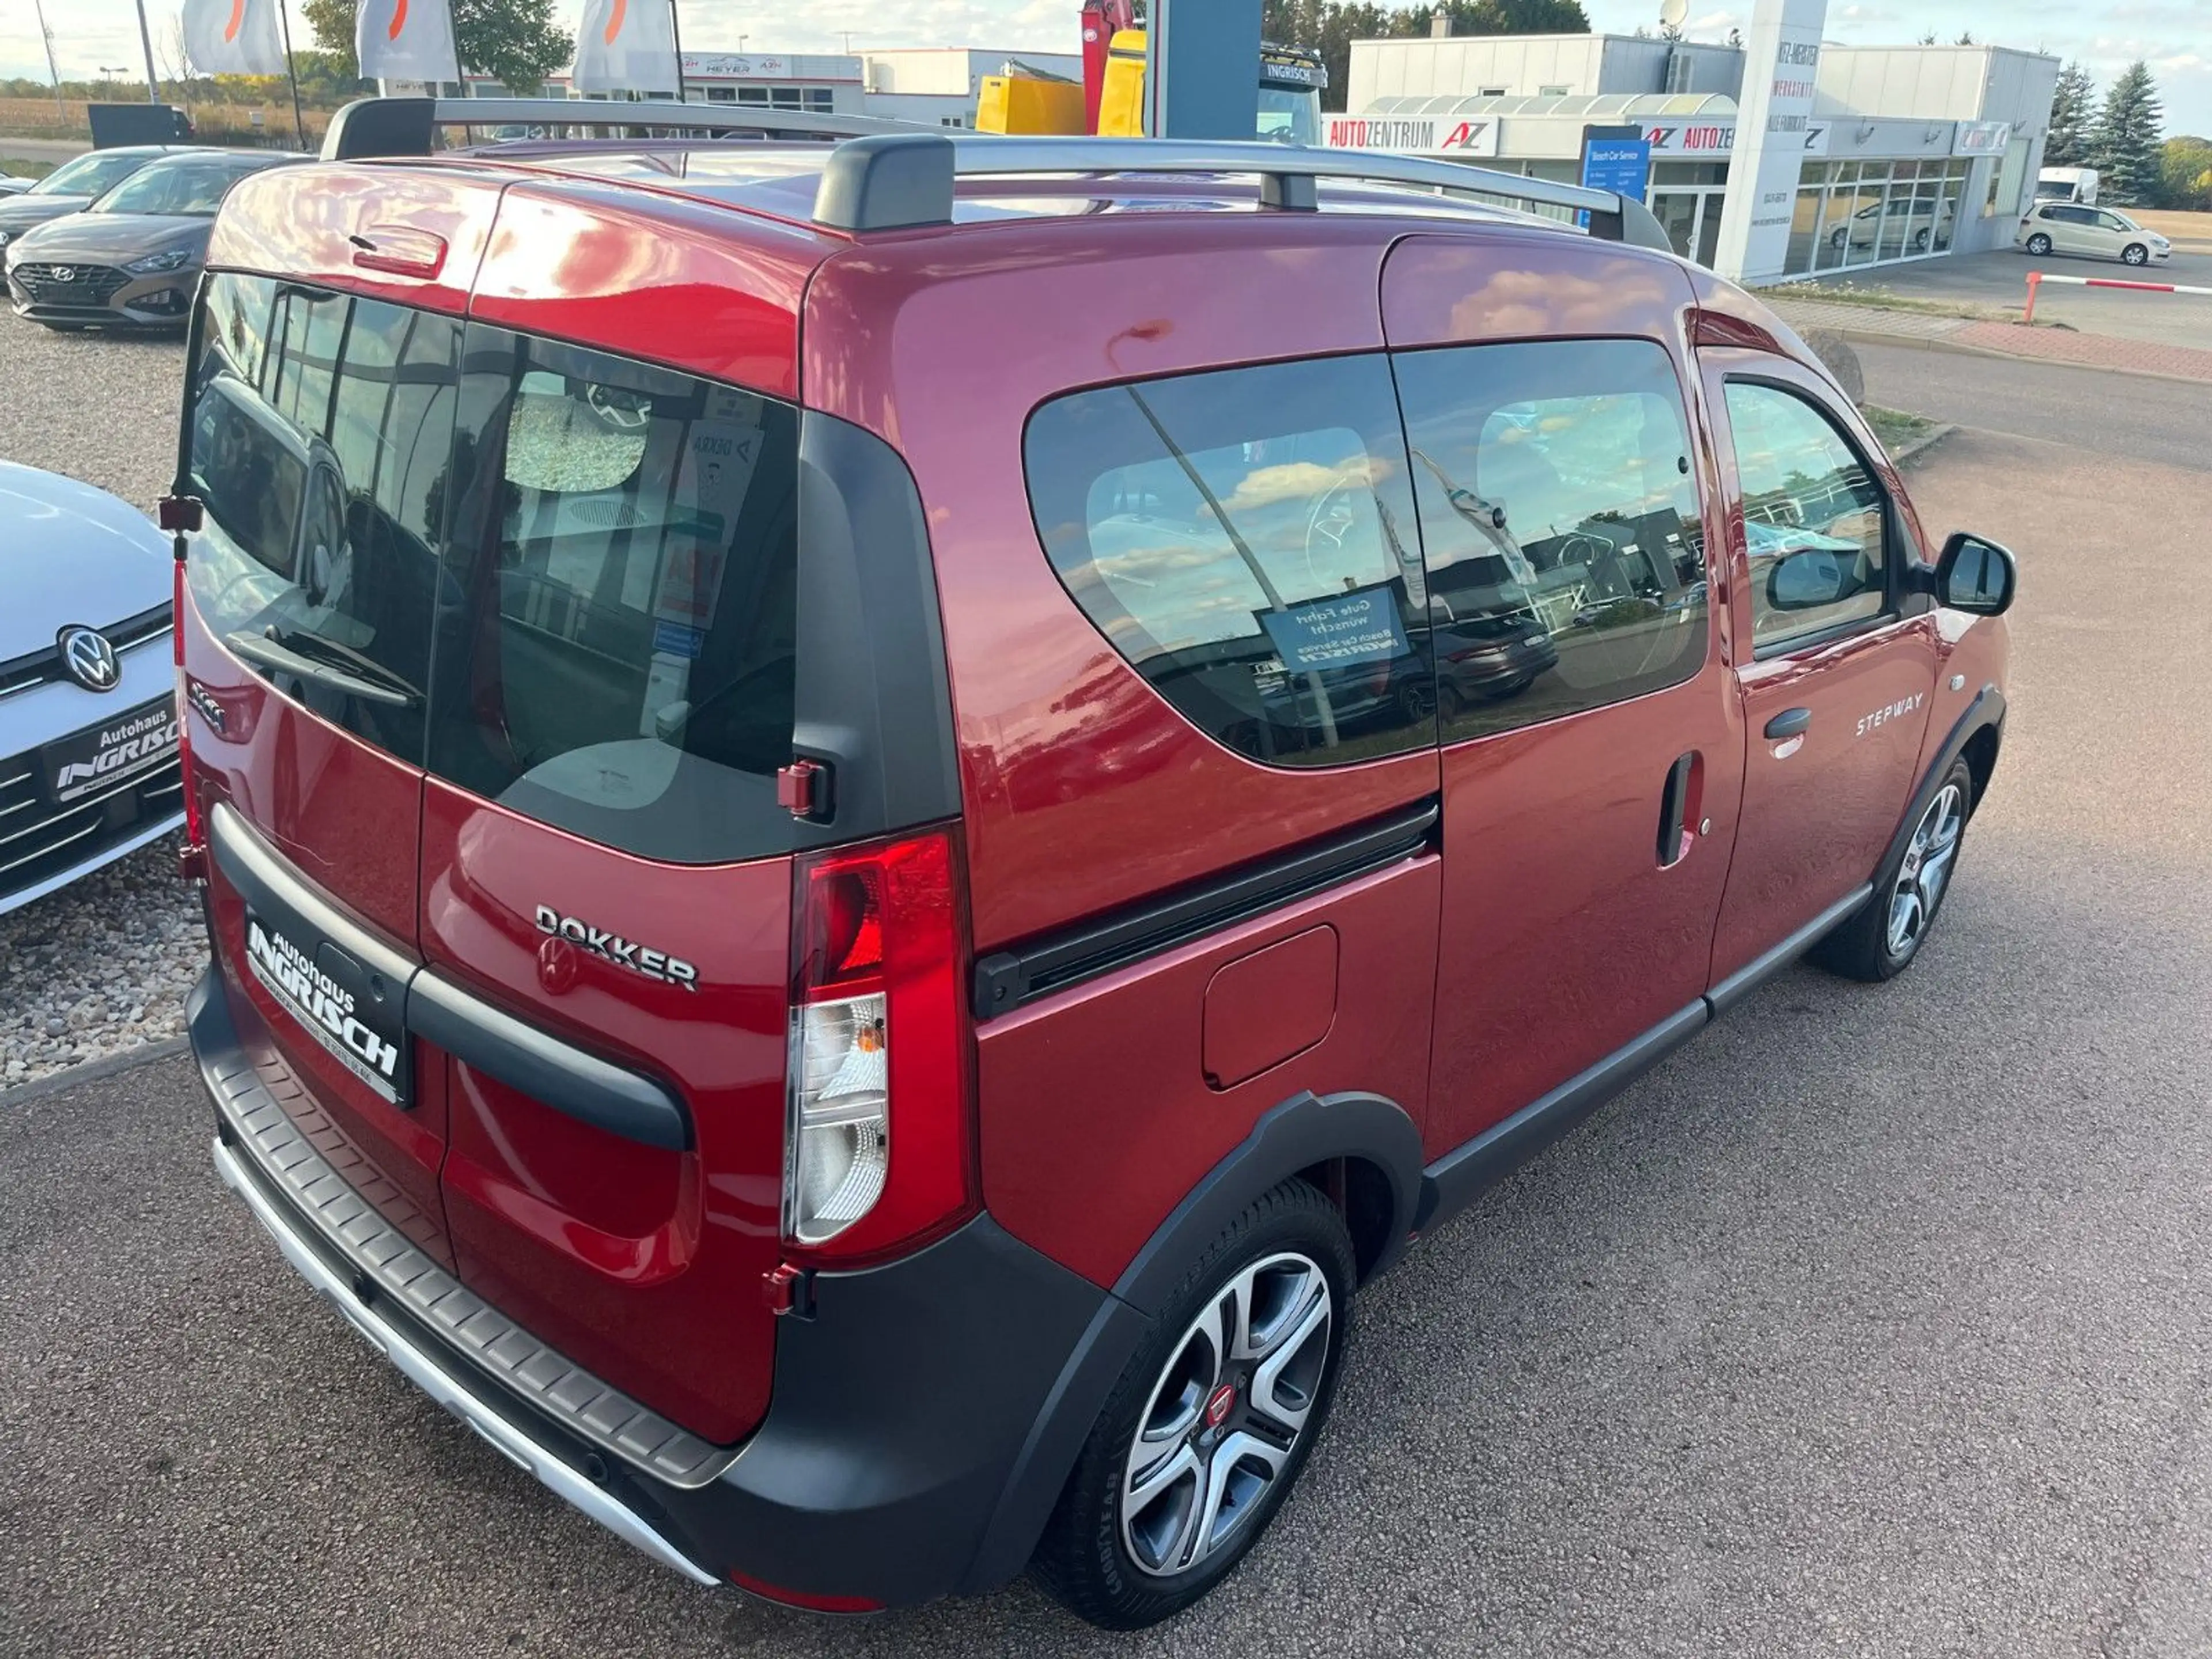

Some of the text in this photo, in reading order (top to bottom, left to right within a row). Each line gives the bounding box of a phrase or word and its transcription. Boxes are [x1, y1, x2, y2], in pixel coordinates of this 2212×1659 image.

[706, 65, 751, 73] HEYER
[1268, 65, 1310, 81] INGRISCH
[1330, 120, 1489, 149] AUTOZENTRUM AZ
[100, 710, 167, 747] Autohaus
[1855, 692, 1923, 736] STEPWAY
[57, 721, 180, 789] INGRISC
[536, 903, 698, 993] DOKKER
[273, 931, 355, 1013] Autohaus
[248, 921, 398, 1076] INGRISCH
